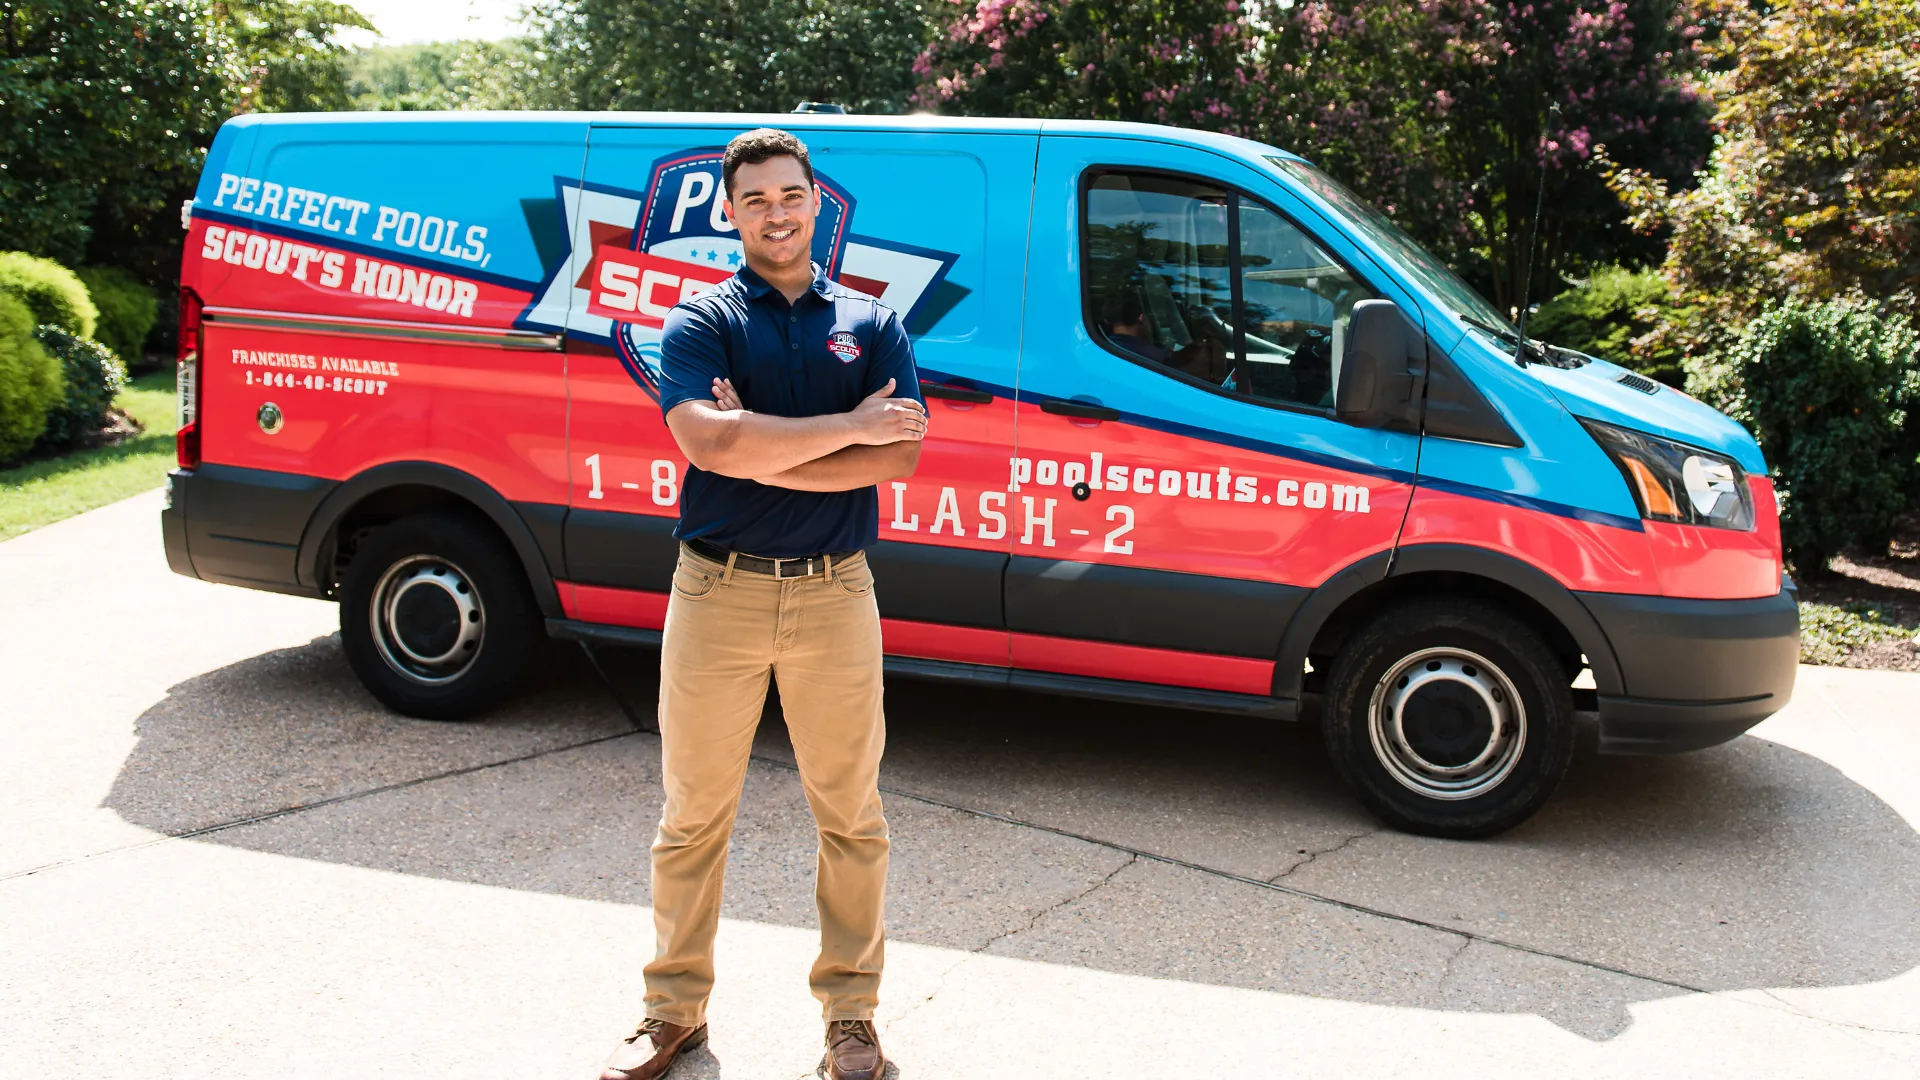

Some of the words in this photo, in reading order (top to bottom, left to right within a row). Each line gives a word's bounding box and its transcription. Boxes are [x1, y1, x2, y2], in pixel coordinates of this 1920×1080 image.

[212, 173, 370, 236] PERFECT
[372, 205, 492, 268] POOLS,
[202, 226, 345, 288] SCOUT'S
[351, 258, 479, 318] HONOR
[231, 349, 317, 370] FRANCHISES
[321, 356, 400, 376] AVAILABLE
[829, 344, 860, 357] SCOUTS
[1007, 451, 1371, 513] poolscouts.com
